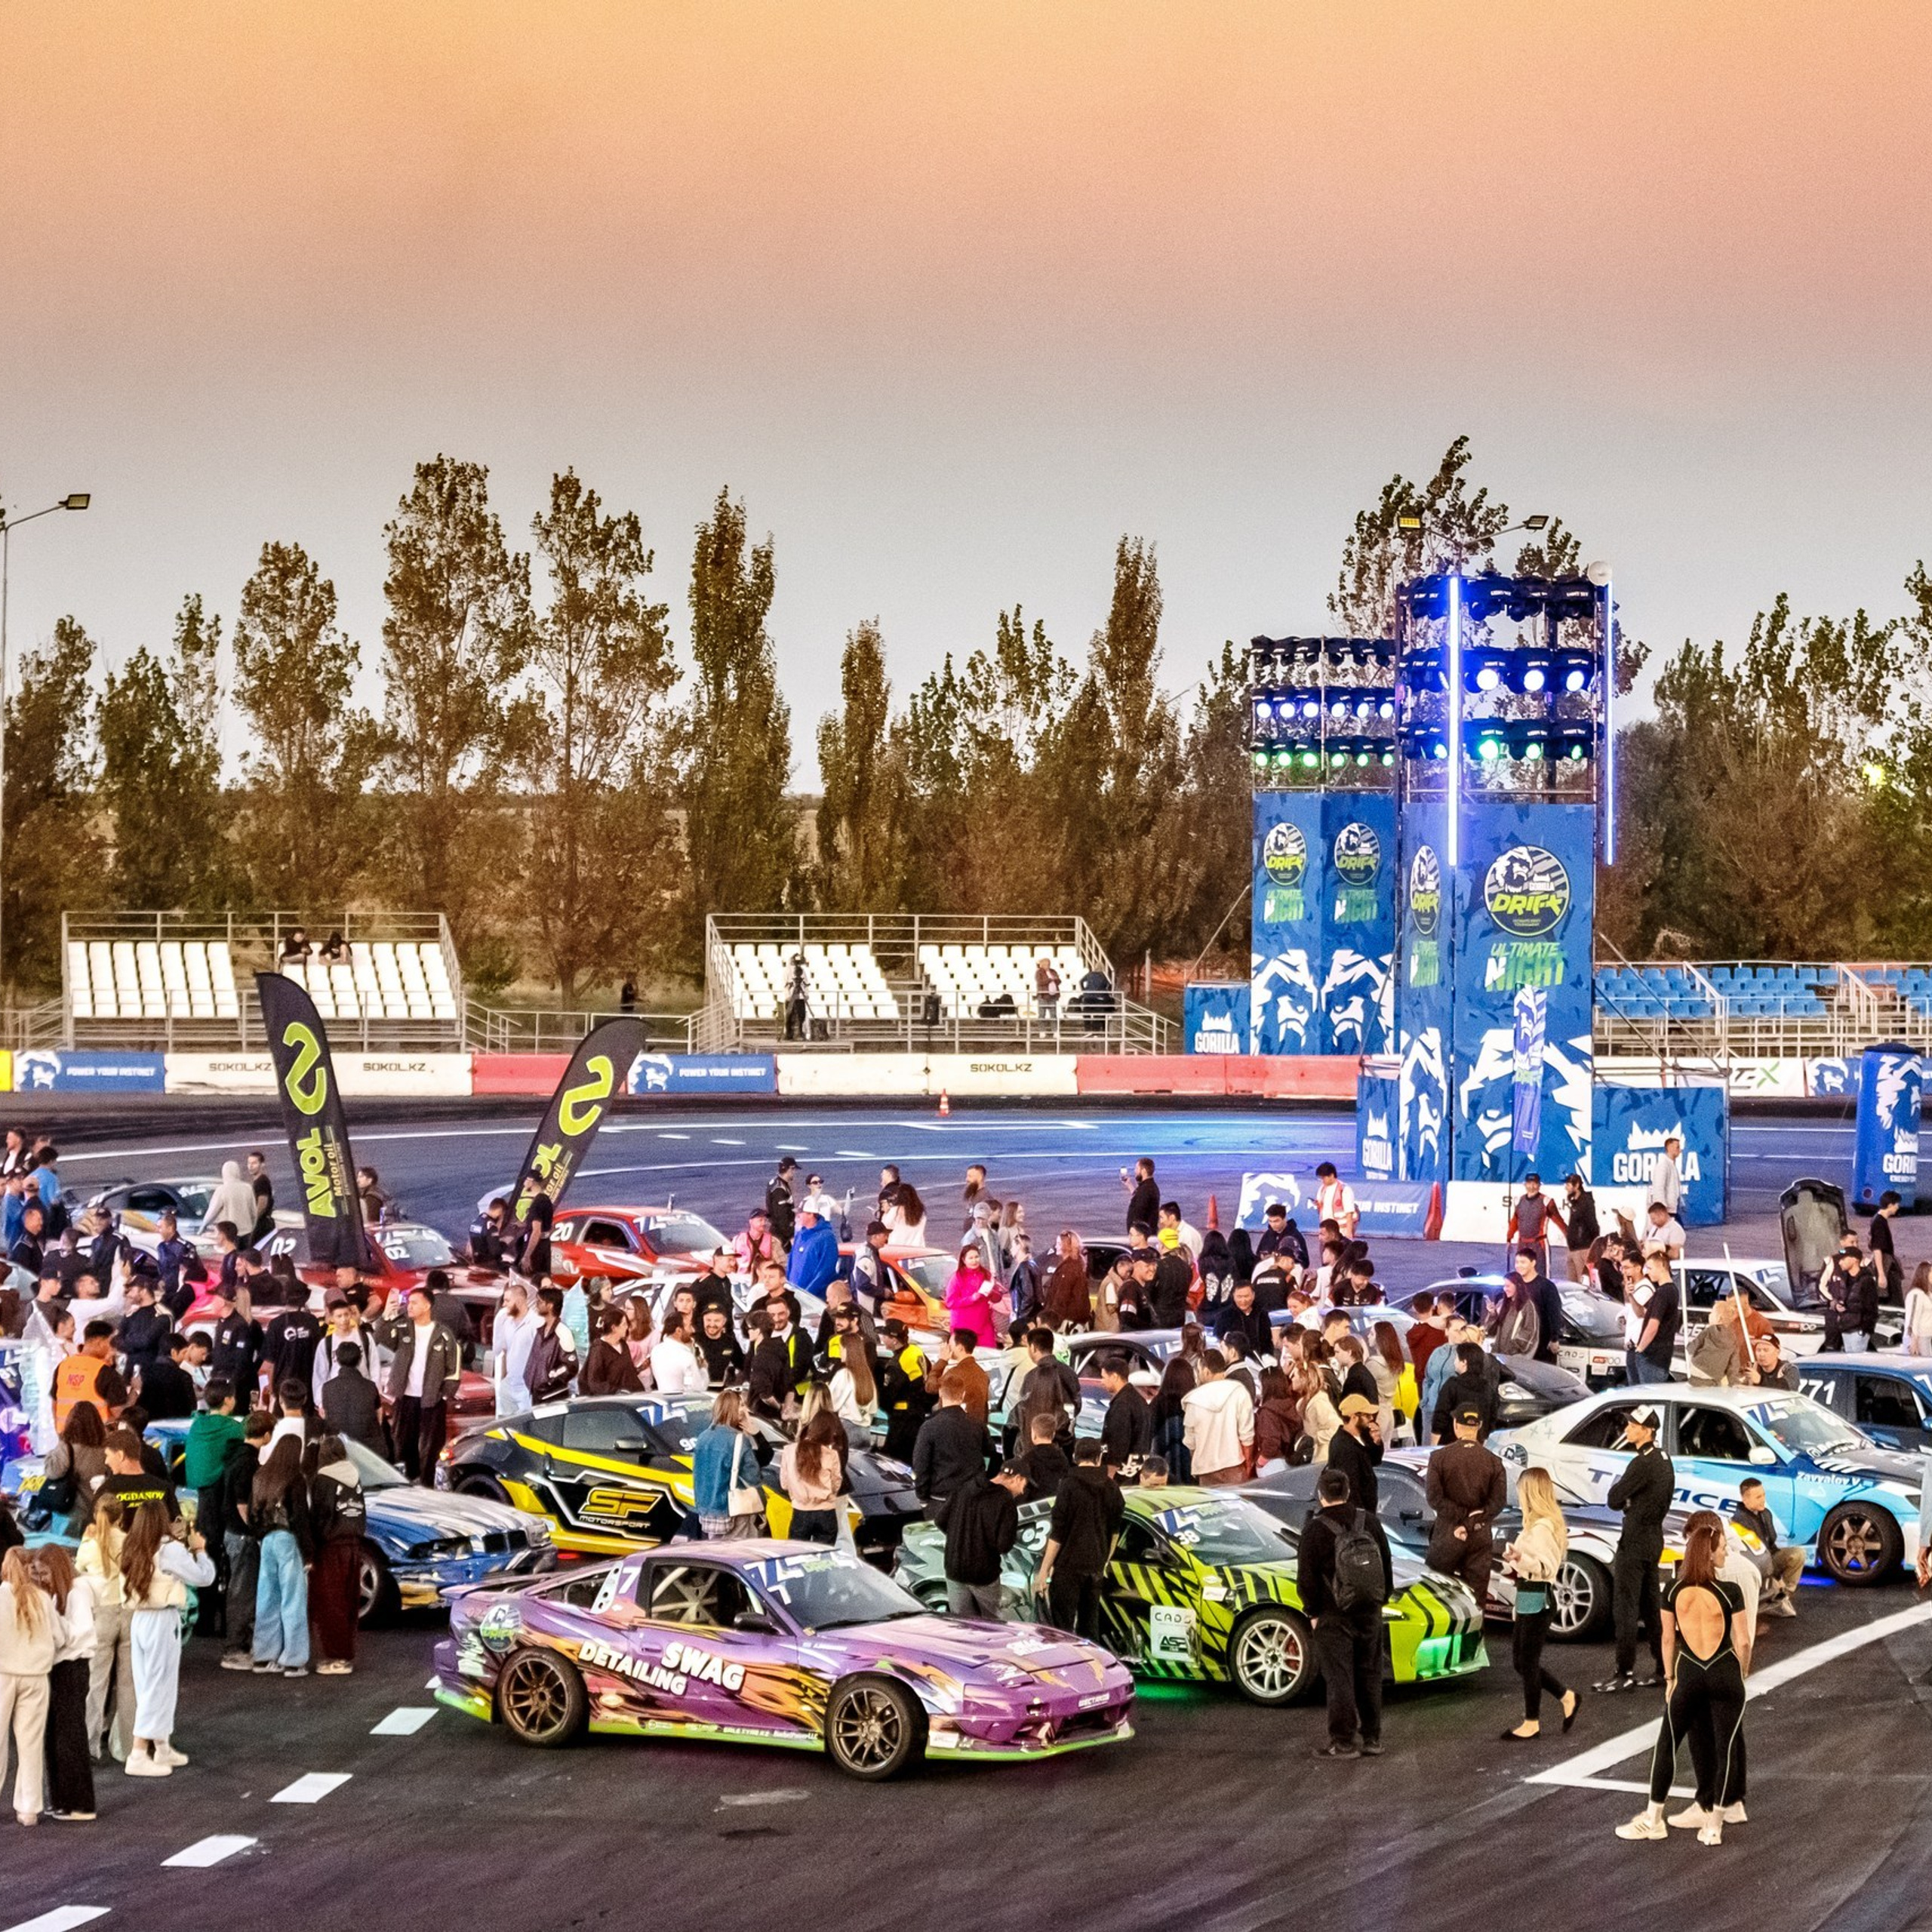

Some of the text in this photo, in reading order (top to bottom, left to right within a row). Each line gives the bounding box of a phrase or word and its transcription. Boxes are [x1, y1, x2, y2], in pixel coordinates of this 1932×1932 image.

[1491, 893, 1563, 916] DRIFT
[1491, 943, 1561, 957] ULTIMATE
[1484, 955, 1564, 992] NIGHT
[1195, 1032, 1240, 1054] GORILLA
[679, 1068, 706, 1078] POWER
[731, 1067, 766, 1077] INSTINCT
[296, 1128, 337, 1218] AVOL
[1613, 1151, 1701, 1184] GORLA
[515, 1143, 563, 1223] AOL
[1373, 1201, 1420, 1214] INSTINCT
[549, 1222, 574, 1242] 20
[579, 1487, 662, 1518] SF
[578, 1514, 651, 1530] MOTORSPORT
[1174, 1529, 1201, 1546] 38
[617, 1566, 641, 1595] 7
[578, 1641, 688, 1696] DETAILING
[661, 1641, 746, 1691] SWAG
